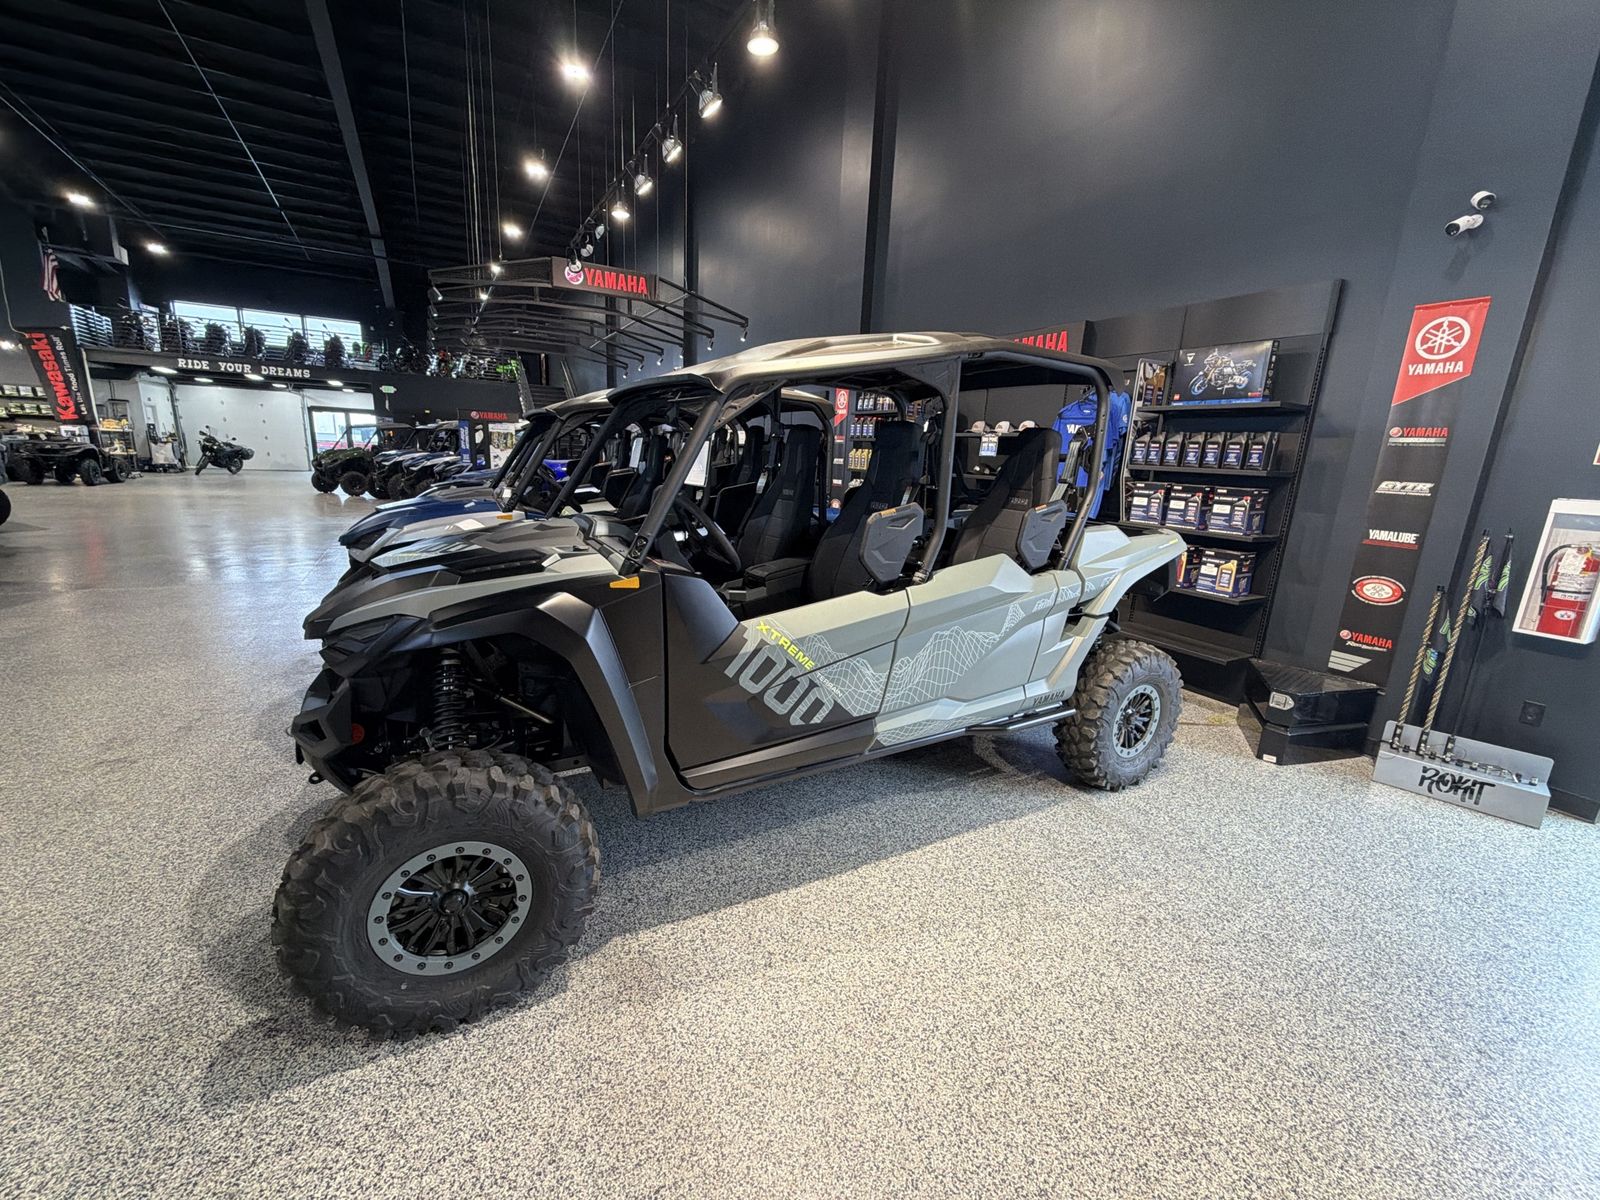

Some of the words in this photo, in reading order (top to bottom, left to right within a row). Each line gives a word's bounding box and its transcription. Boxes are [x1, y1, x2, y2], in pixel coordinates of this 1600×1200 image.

[584, 267, 648, 295] YAMAHA
[27, 332, 80, 420] Kawasaki
[177, 358, 210, 370] RIDE
[218, 362, 252, 374] YOUR
[261, 365, 311, 379] DREAMS
[1408, 361, 1464, 376] YAMAHA
[479, 411, 508, 420] YAMAHA
[1403, 427, 1449, 437] YAMAHA
[1378, 481, 1435, 493] GYTR
[1369, 529, 1419, 544] YAMALUBE
[756, 620, 816, 671] XTREME
[1352, 632, 1393, 649] YAMAHA
[723, 620, 835, 726] 1000
[816, 672, 843, 698] TERRAIN
[1033, 690, 1066, 706] YAMAHA
